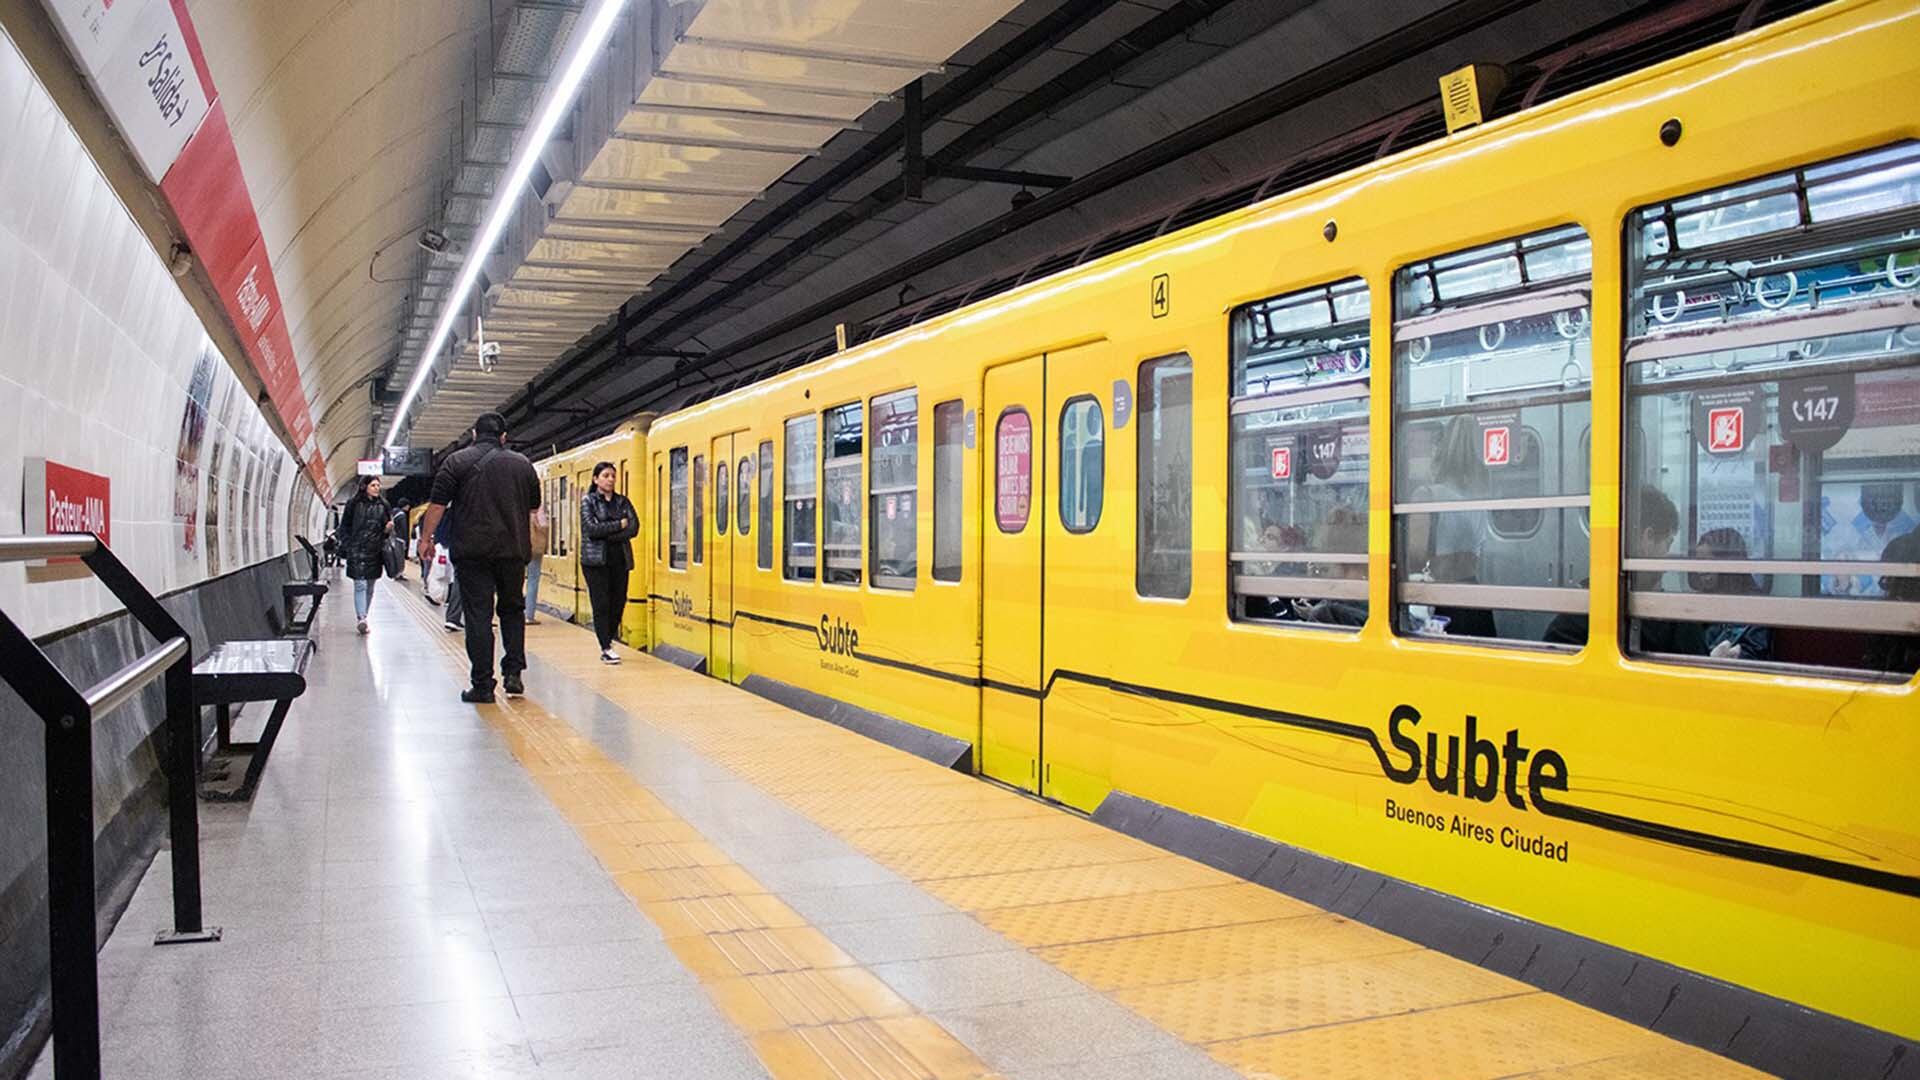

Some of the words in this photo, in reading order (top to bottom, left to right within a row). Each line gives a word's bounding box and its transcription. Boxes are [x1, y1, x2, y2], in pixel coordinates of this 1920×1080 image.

[148, 52, 185, 120] Salida
[1155, 281, 1166, 309] 4
[1804, 397, 1839, 422] 147
[1318, 442, 1336, 459] 147
[49, 489, 105, 534] Pasteur-AMIA
[820, 613, 859, 657] Subte
[1387, 703, 1568, 815] Subte
[1385, 798, 1446, 832] Buenos
[1449, 814, 1494, 846] Aires
[1499, 826, 1569, 863] Ciudad
